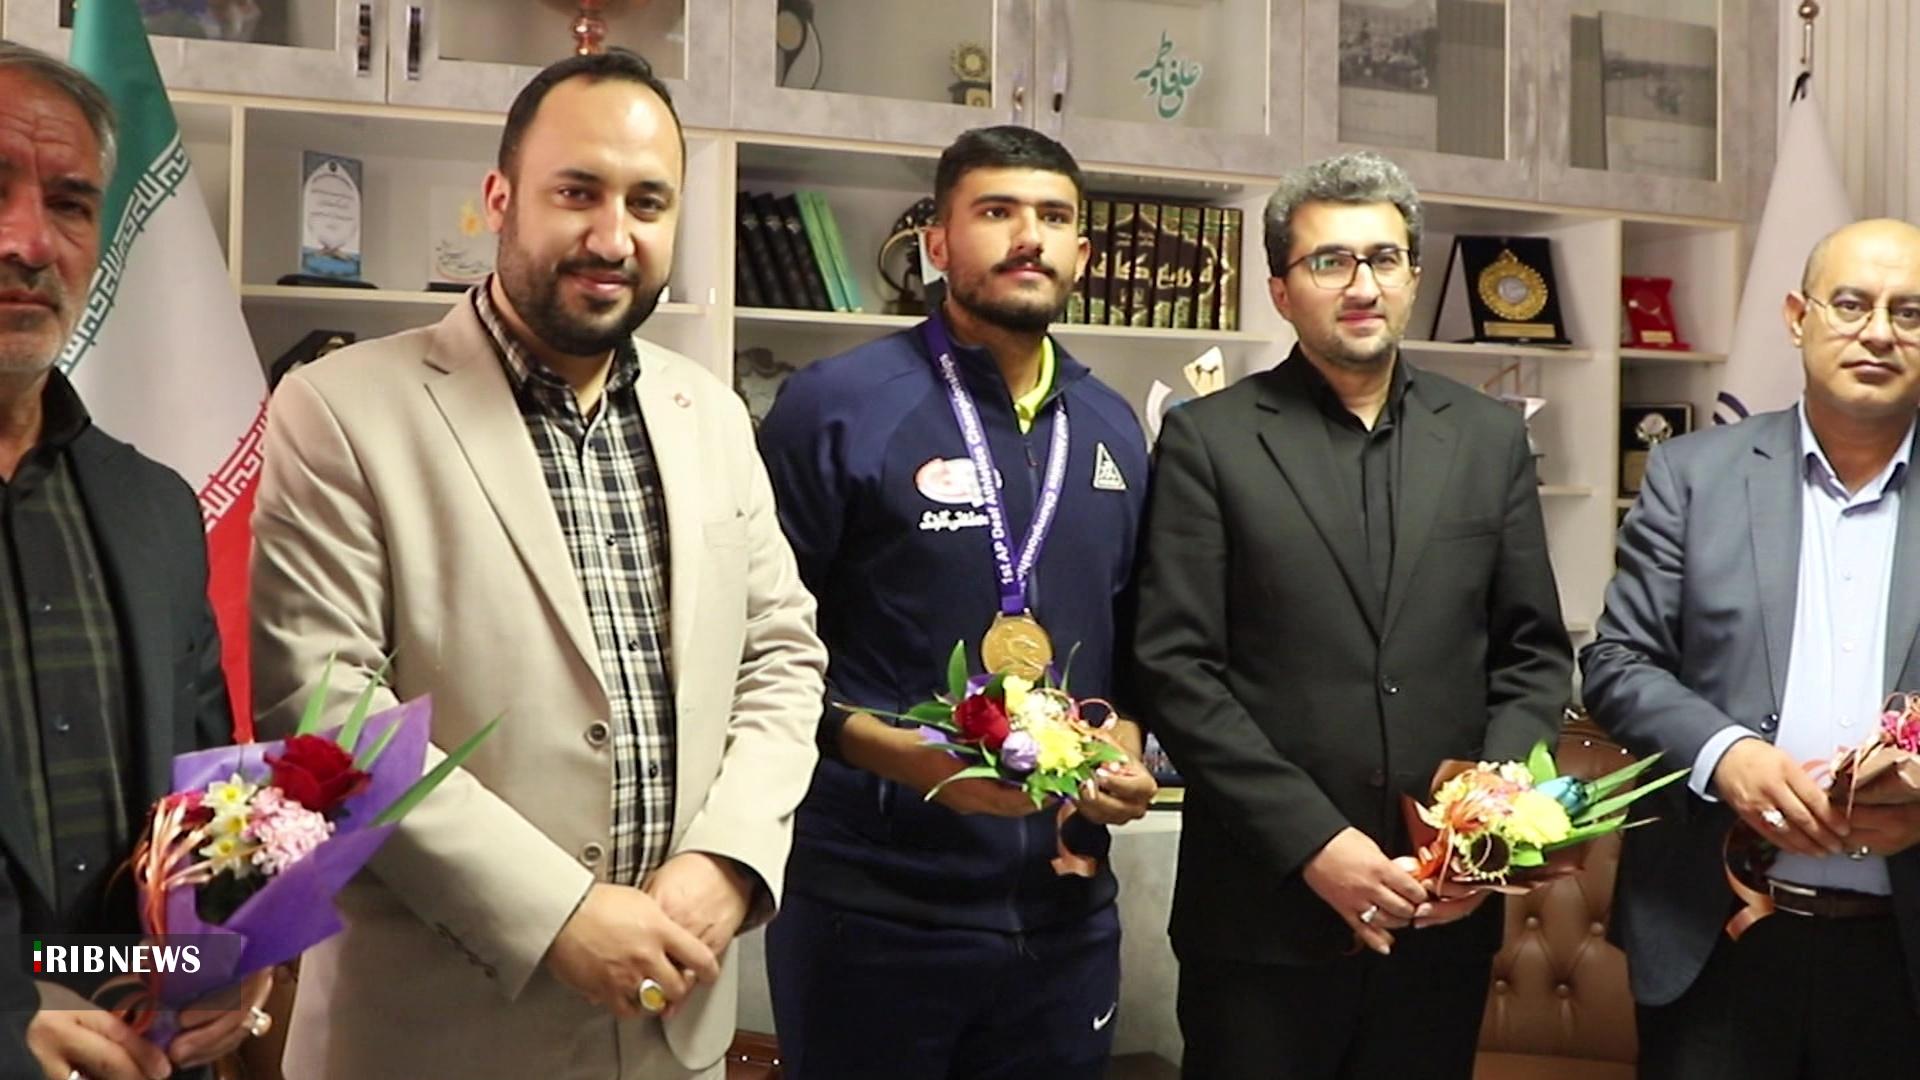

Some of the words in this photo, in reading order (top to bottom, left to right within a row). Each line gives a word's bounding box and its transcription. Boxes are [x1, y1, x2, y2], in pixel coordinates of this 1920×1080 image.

[939, 352, 981, 445] Championships
[974, 445, 999, 505] Athletics
[986, 506, 1005, 539] Deaf
[993, 540, 1010, 562] AP
[999, 563, 1014, 585] 1st
